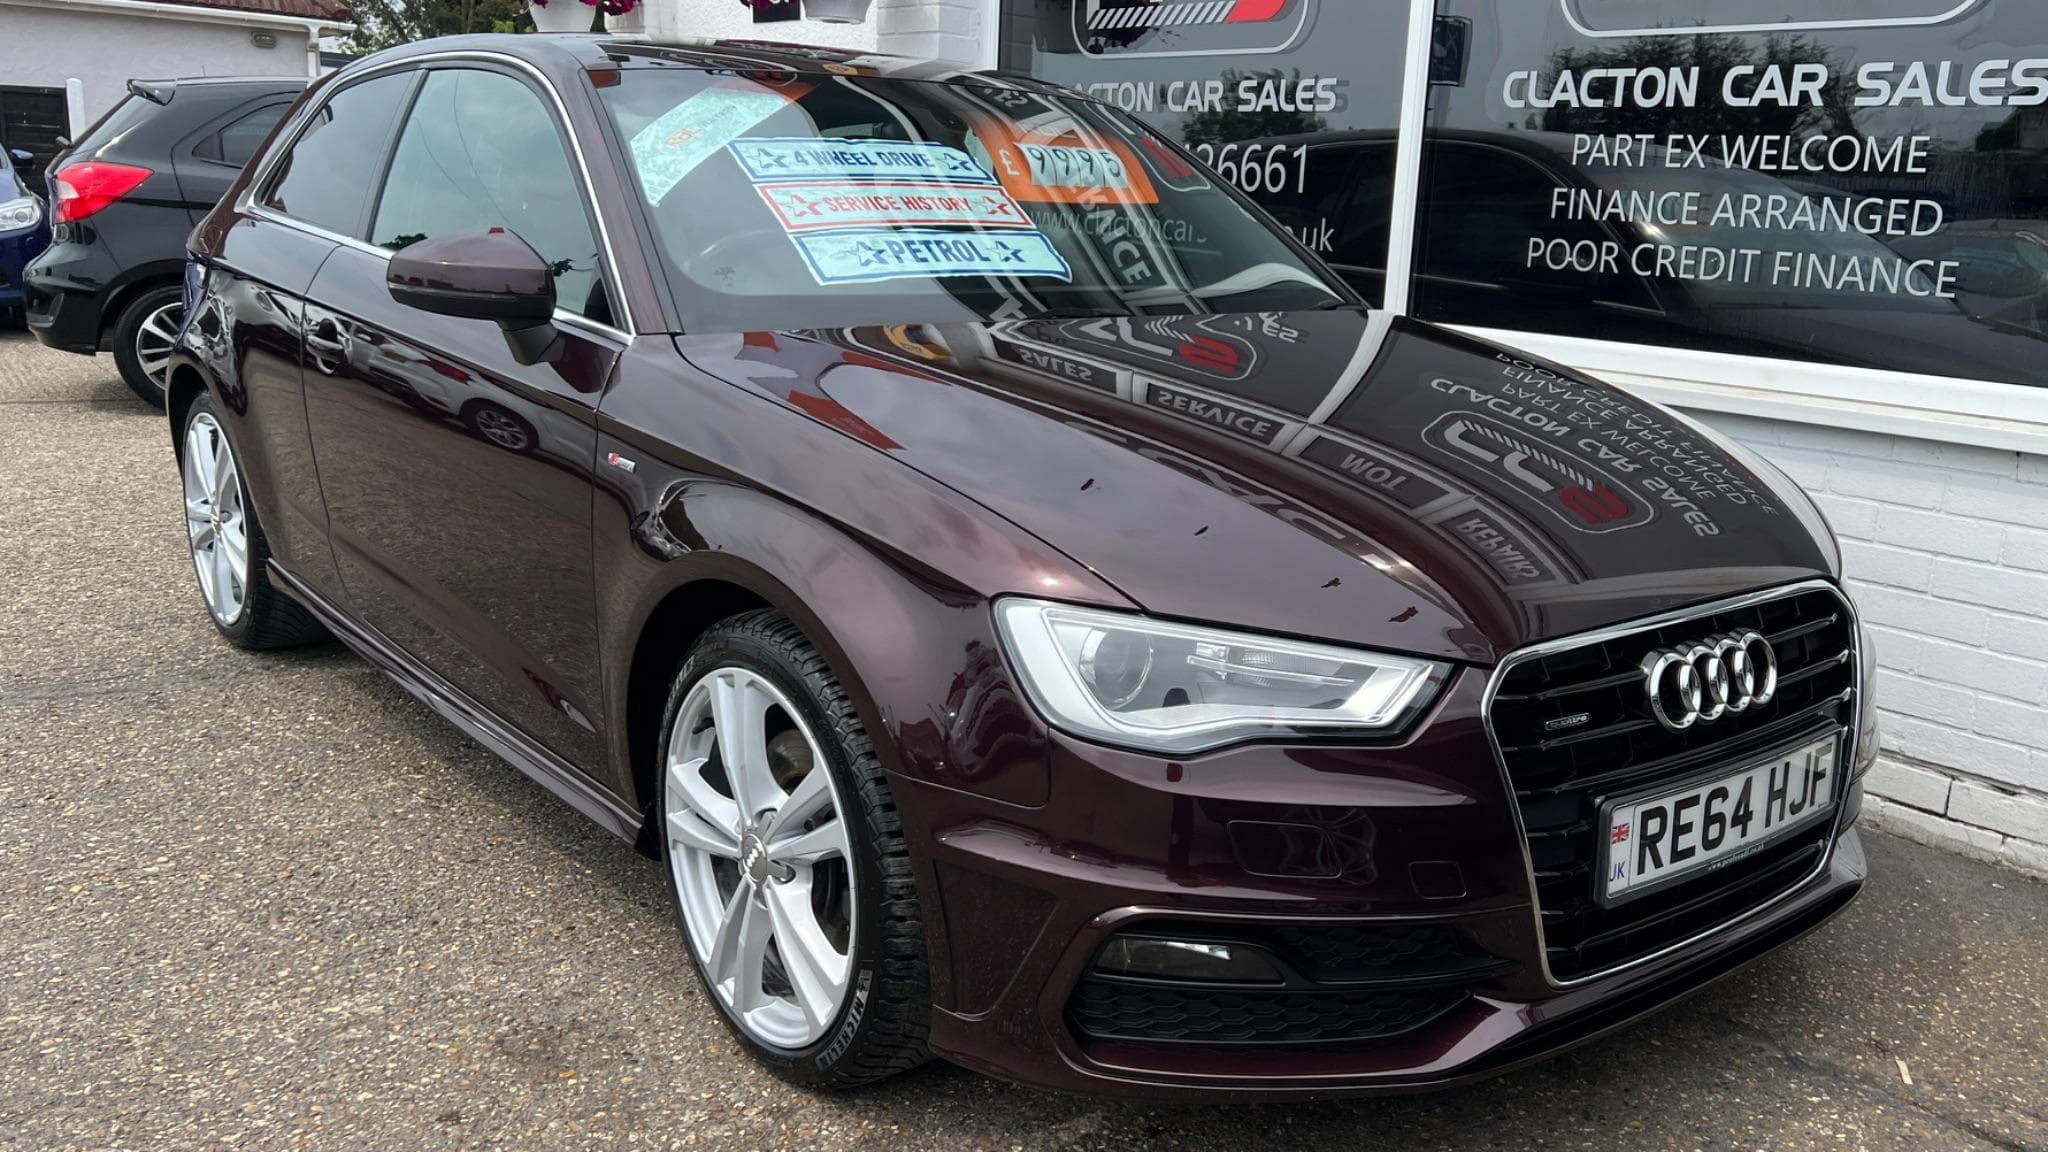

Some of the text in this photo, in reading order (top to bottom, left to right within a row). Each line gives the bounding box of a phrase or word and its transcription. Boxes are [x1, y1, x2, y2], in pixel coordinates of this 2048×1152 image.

[1167, 80, 1225, 112] CAR
[1237, 78, 1337, 113] SALES
[1503, 59, 2048, 108] CLACTON CAR SALES
[794, 150, 935, 168] 4 WHEEL DRIVE
[1190, 143, 1307, 194] 26661
[1572, 133, 1930, 174] PART EX WELCOME
[822, 196, 971, 213] SERVICE HISTORY
[1551, 187, 1943, 237] FINANCE ARRANGED
[891, 239, 992, 264] PETROL
[1527, 237, 1959, 298] POOR CREDIT FINANCE
[1637, 742, 1834, 875] RE64 HJF
[818, 996, 865, 1067] MICHELIN
